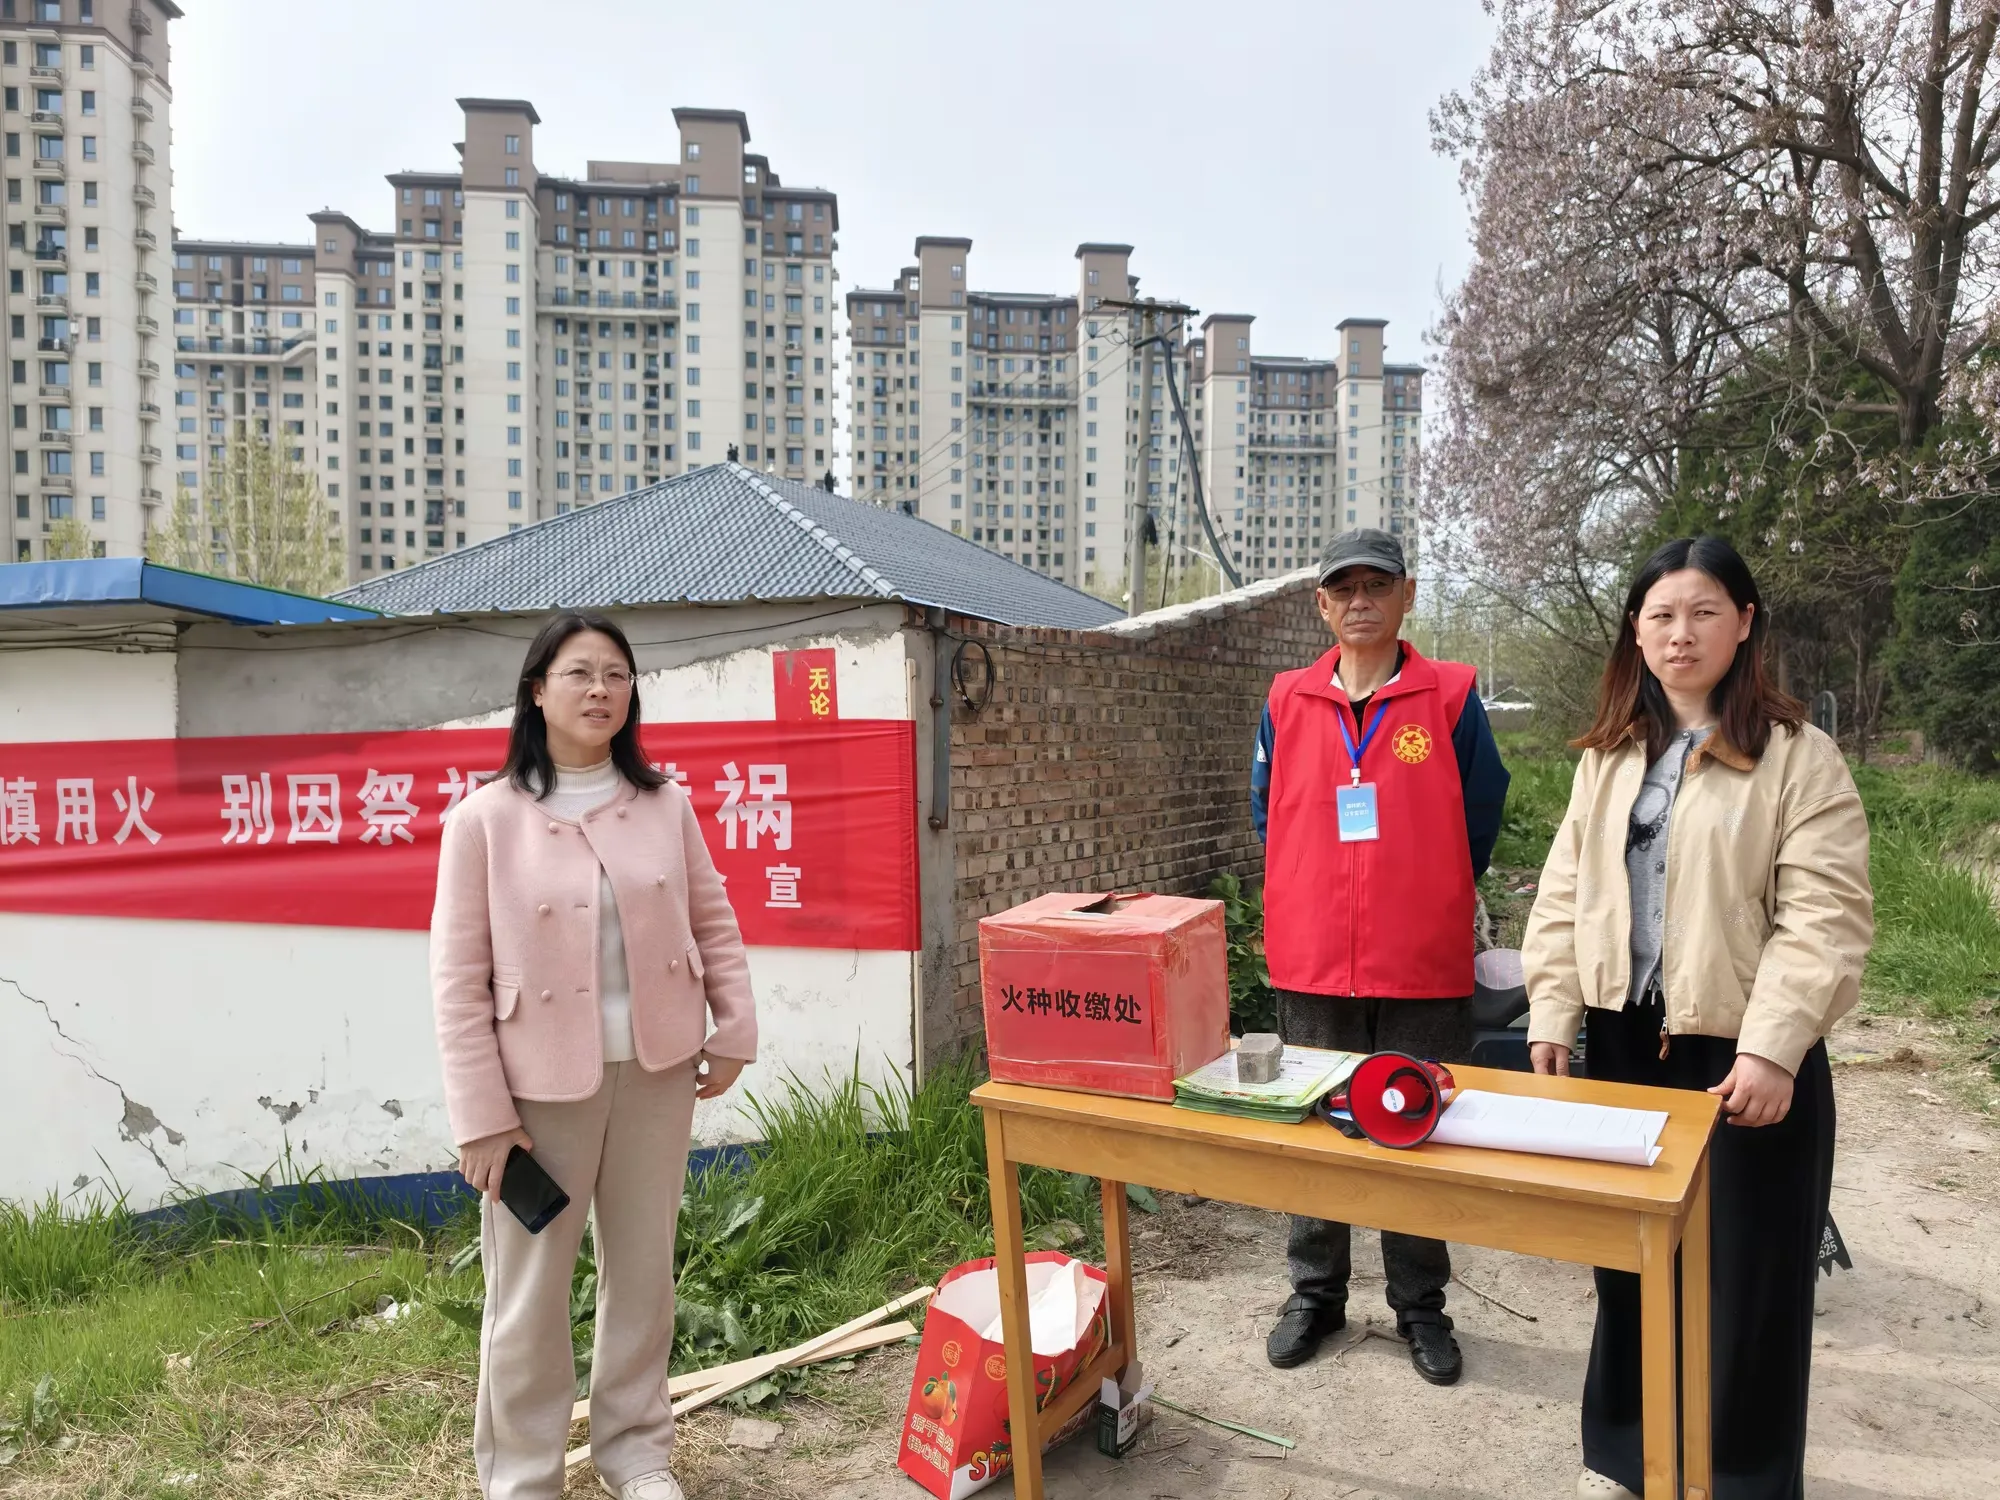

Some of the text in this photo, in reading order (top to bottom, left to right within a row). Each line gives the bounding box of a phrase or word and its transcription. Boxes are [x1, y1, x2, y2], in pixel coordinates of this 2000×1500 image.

[808, 667, 831, 716] 无论
[0, 776, 162, 846] 慎用火
[765, 863, 802, 908] 宣
[1000, 984, 1142, 1025] 火种收缴处
[911, 1412, 955, 1457] 源于自然
[969, 1451, 1013, 1481] SW
